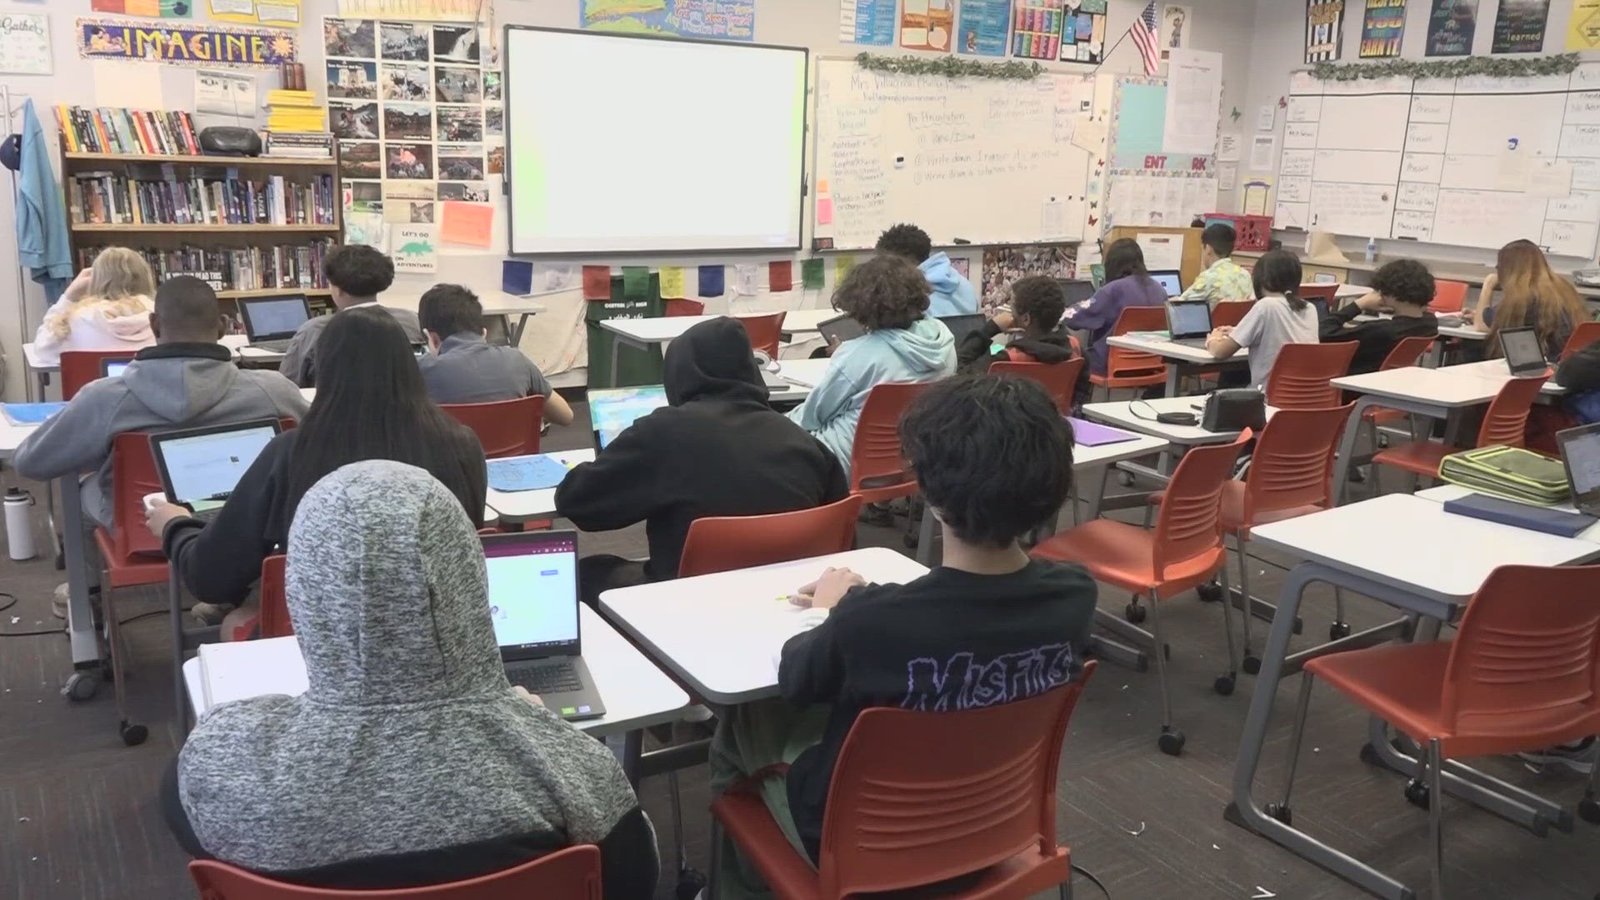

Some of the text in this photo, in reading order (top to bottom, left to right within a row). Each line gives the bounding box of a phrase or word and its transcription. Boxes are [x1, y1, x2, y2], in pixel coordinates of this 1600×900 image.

[1507, 32, 1541, 41] learned
[123, 28, 266, 62] IMAGINE
[1144, 156, 1207, 170] ENT RK
[210, 272, 222, 280] THIS
